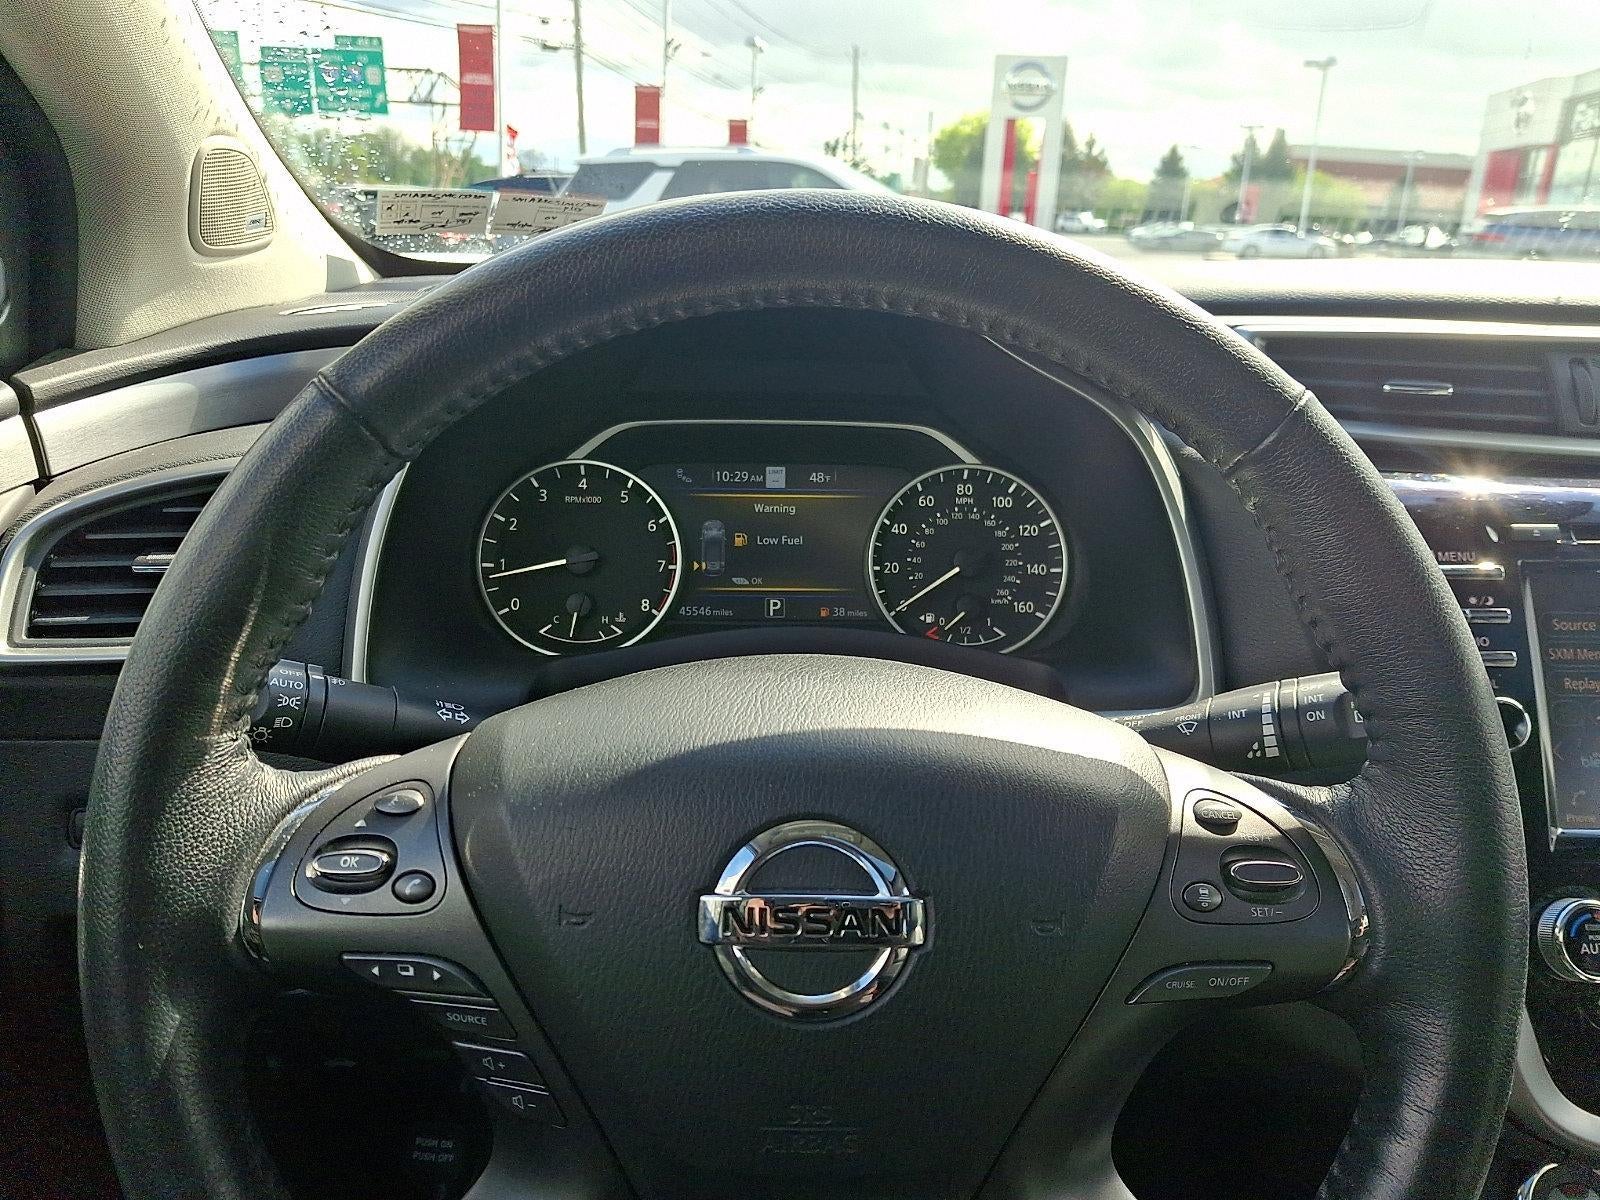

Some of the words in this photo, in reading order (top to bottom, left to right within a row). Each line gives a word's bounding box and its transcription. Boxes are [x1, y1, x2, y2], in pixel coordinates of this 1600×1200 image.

[716, 471, 749, 482] 10:29
[578, 479, 587, 490] 4
[956, 484, 973, 496] 80
[539, 490, 547, 501] 3
[621, 492, 628, 503] 5
[918, 496, 935, 507] 60
[992, 497, 1013, 508] 100
[754, 504, 796, 515] Warning
[509, 518, 517, 531] 2
[648, 520, 657, 532] 6
[936, 518, 949, 526] 100
[891, 524, 907, 535] 40
[1018, 525, 1039, 536] 120
[757, 536, 780, 545] Low
[781, 535, 803, 545] Fuel
[1001, 543, 1014, 551] 200
[912, 556, 922, 564] 40
[1437, 551, 1476, 561] MENU
[500, 559, 505, 570] 1
[658, 561, 666, 572] 7
[884, 563, 899, 574] 20
[1026, 564, 1047, 575] 140
[751, 577, 763, 585] OK
[511, 598, 520, 610] 0
[641, 599, 650, 611] 8
[769, 600, 781, 616] P
[1013, 601, 1034, 613] 160
[679, 606, 712, 616] 45546
[712, 608, 733, 616] miles
[832, 607, 845, 617] 38
[847, 609, 868, 617] miles
[553, 615, 560, 624] C
[602, 616, 608, 624] H
[939, 617, 946, 626] 0
[1552, 619, 1596, 631] Source
[1549, 648, 1574, 660] SXM
[269, 677, 304, 690] AUTO
[1304, 693, 1324, 705] INT
[1174, 714, 1201, 722] FRONT
[1228, 709, 1247, 720] INT
[1306, 710, 1326, 722] ON
[1202, 810, 1238, 820] CANCEL
[340, 856, 358, 868] OK
[722, 905, 911, 938] NISSAN
[1581, 943, 1600, 955] AU
[1166, 981, 1195, 989] CRUISE
[1208, 977, 1250, 987] ON/OFF
[446, 1012, 488, 1026] SOURCE
